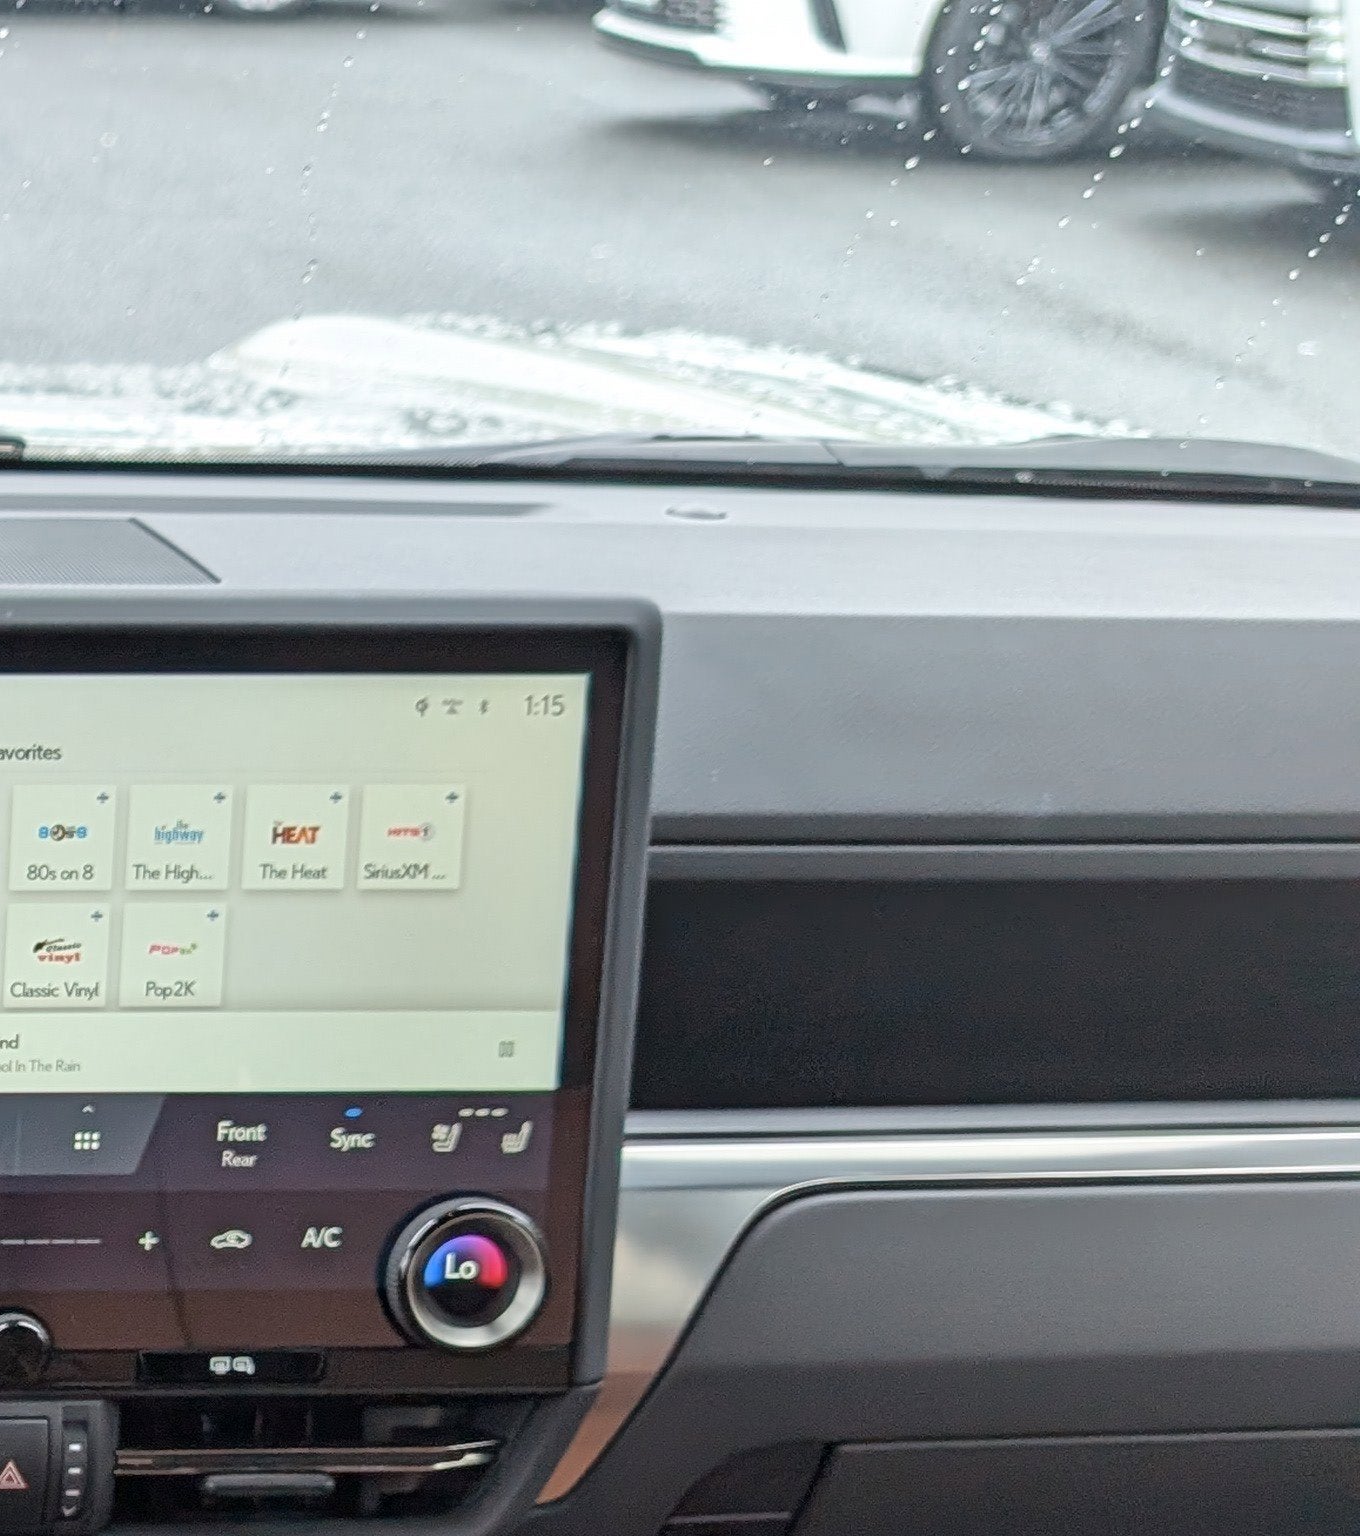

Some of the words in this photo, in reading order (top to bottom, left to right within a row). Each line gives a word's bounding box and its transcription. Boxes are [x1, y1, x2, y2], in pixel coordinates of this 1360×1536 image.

[524, 694, 565, 717] 1:15
[271, 826, 321, 844] HEAT
[26, 864, 57, 881] 80s
[60, 868, 79, 881] on
[82, 864, 95, 881] 8
[133, 864, 161, 881] The
[165, 864, 215, 884] High...
[259, 863, 287, 880] The
[291, 863, 329, 880] Heat
[363, 862, 430, 880] SiriusXM
[10, 981, 60, 999] Classic
[64, 981, 100, 1001] Vinyl
[145, 980, 197, 1000] Pop2K
[15, 1060, 27, 1073] In
[29, 1059, 53, 1073] The
[55, 1059, 82, 1072] Rain
[216, 1121, 266, 1142] Front
[330, 1129, 375, 1152] Sync
[221, 1151, 257, 1167] Rear
[300, 1226, 344, 1249] A/C
[445, 1252, 478, 1281] Lo
